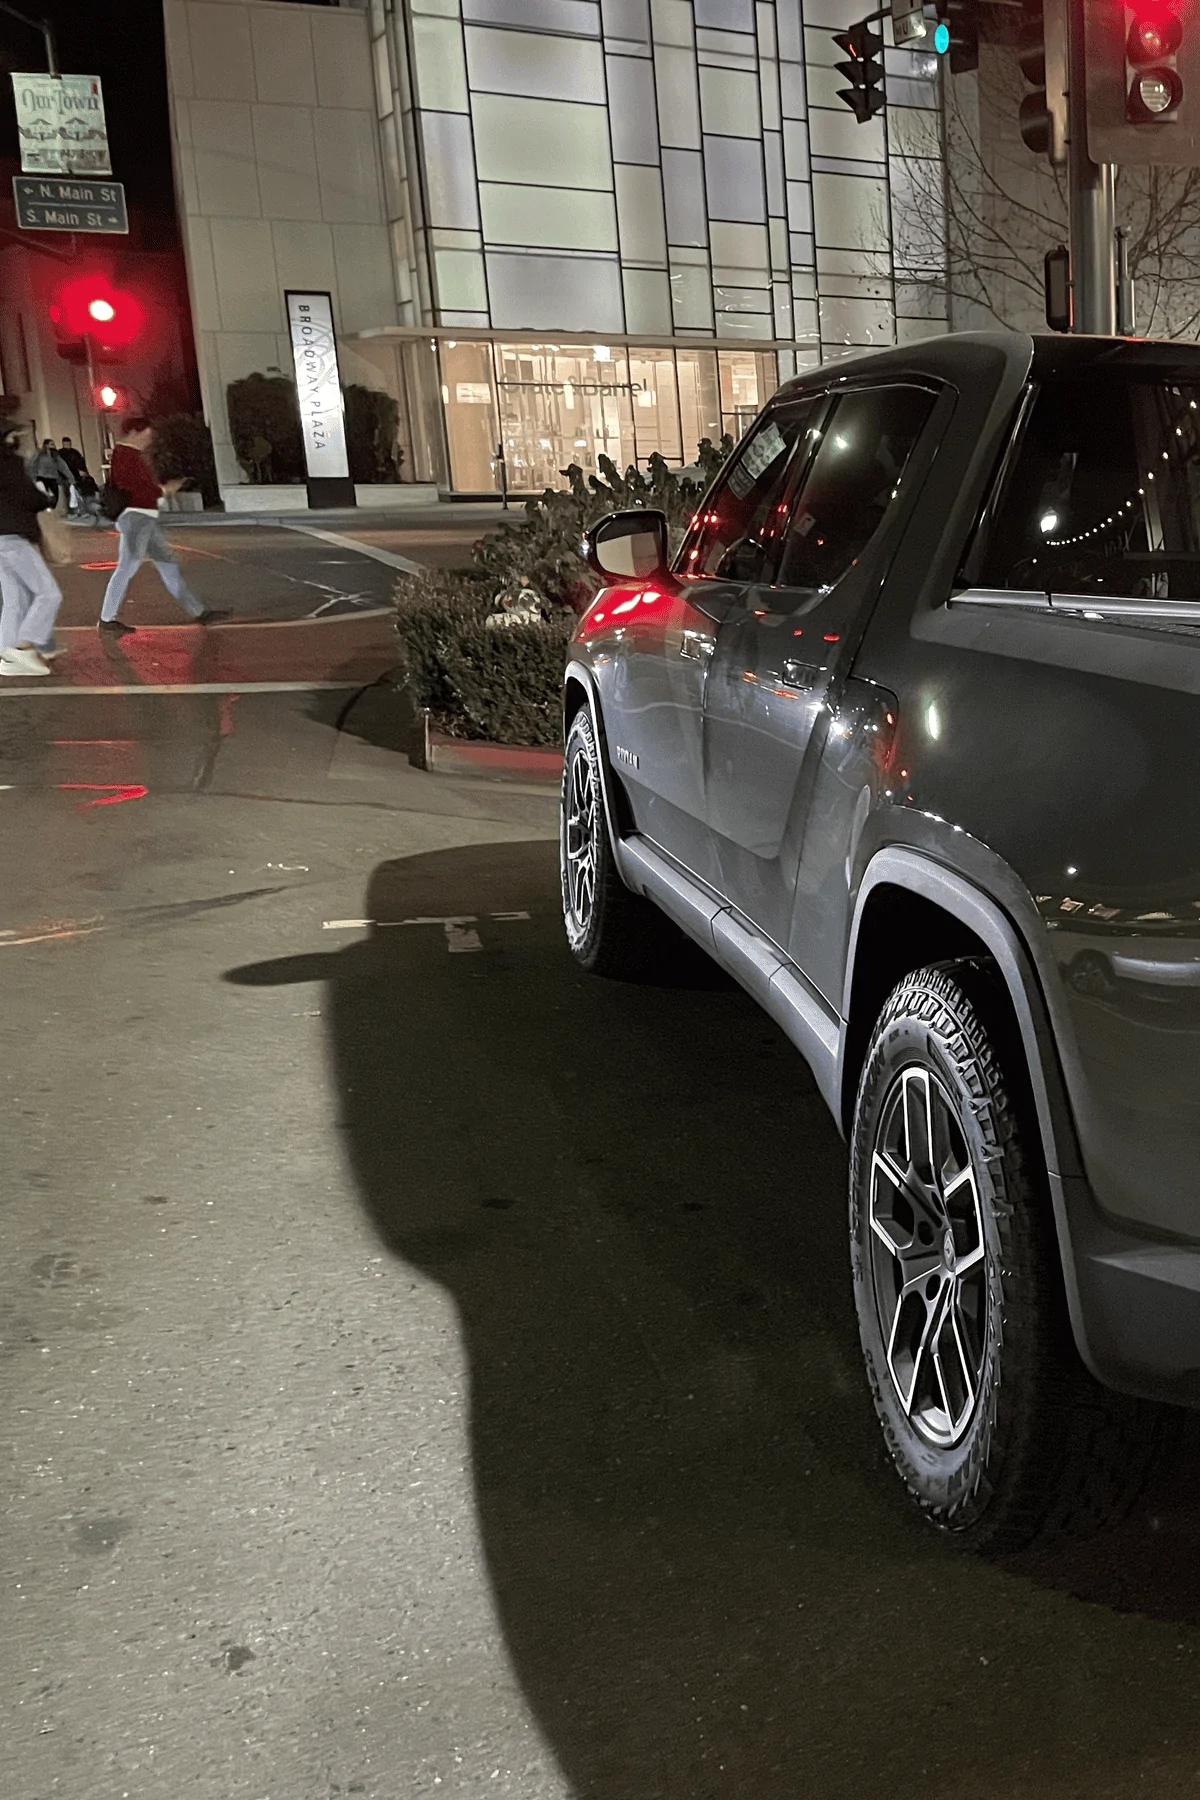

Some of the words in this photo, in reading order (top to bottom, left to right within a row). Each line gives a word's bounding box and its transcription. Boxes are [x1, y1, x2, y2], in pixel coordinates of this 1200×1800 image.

[59, 186, 94, 201] Main
[101, 188, 117, 203] St
[45, 210, 80, 225] Main
[87, 212, 103, 227] St
[298, 304, 320, 394] BROADWAY
[310, 400, 326, 449] PLAZA
